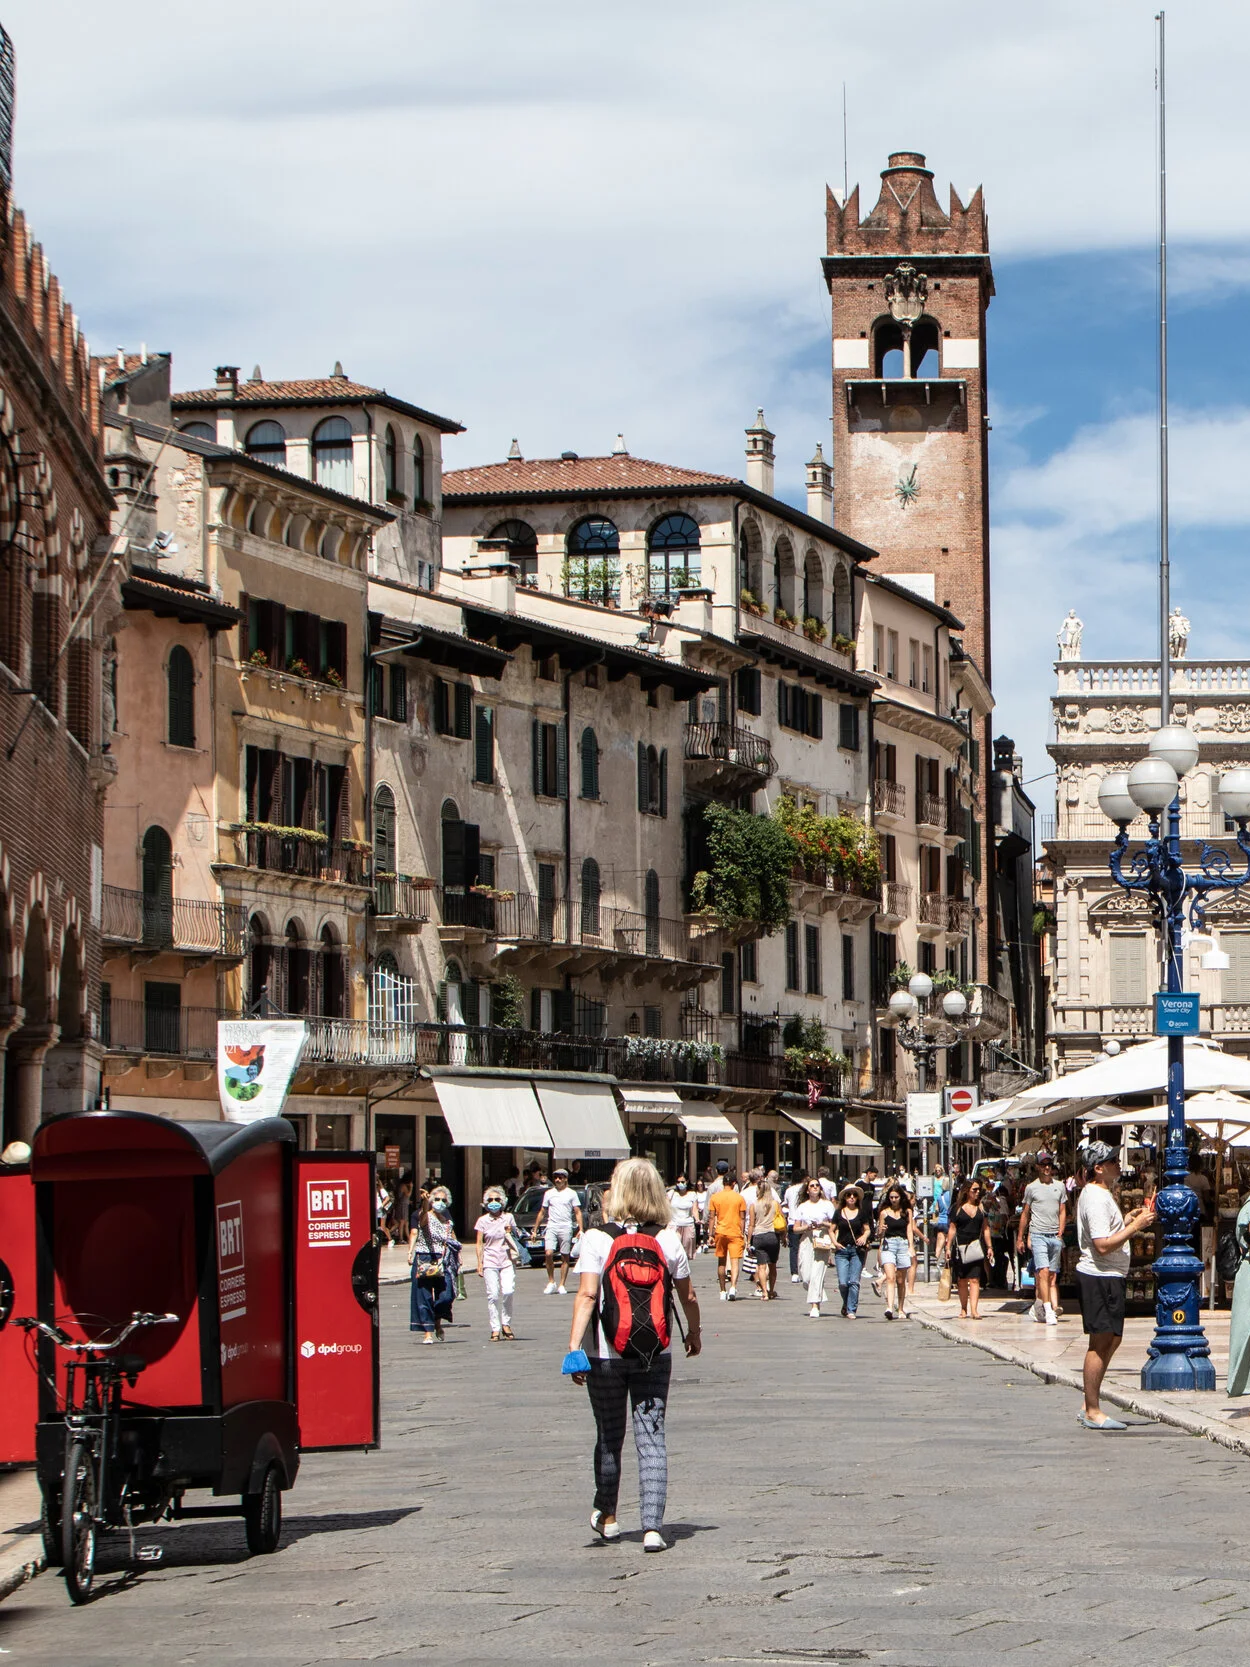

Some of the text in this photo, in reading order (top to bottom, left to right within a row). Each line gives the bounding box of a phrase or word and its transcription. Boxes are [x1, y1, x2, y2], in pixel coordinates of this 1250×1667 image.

[1161, 1000, 1193, 1008] Verona
[311, 1189, 345, 1211] BRT
[308, 1222, 351, 1231] CORRIERE
[220, 1217, 241, 1256] BRT
[308, 1230, 351, 1240] ESPRESSO
[219, 1275, 246, 1292] CORRIERE
[220, 1290, 246, 1308] ESPRESSO
[317, 1343, 363, 1355] dpdgroup
